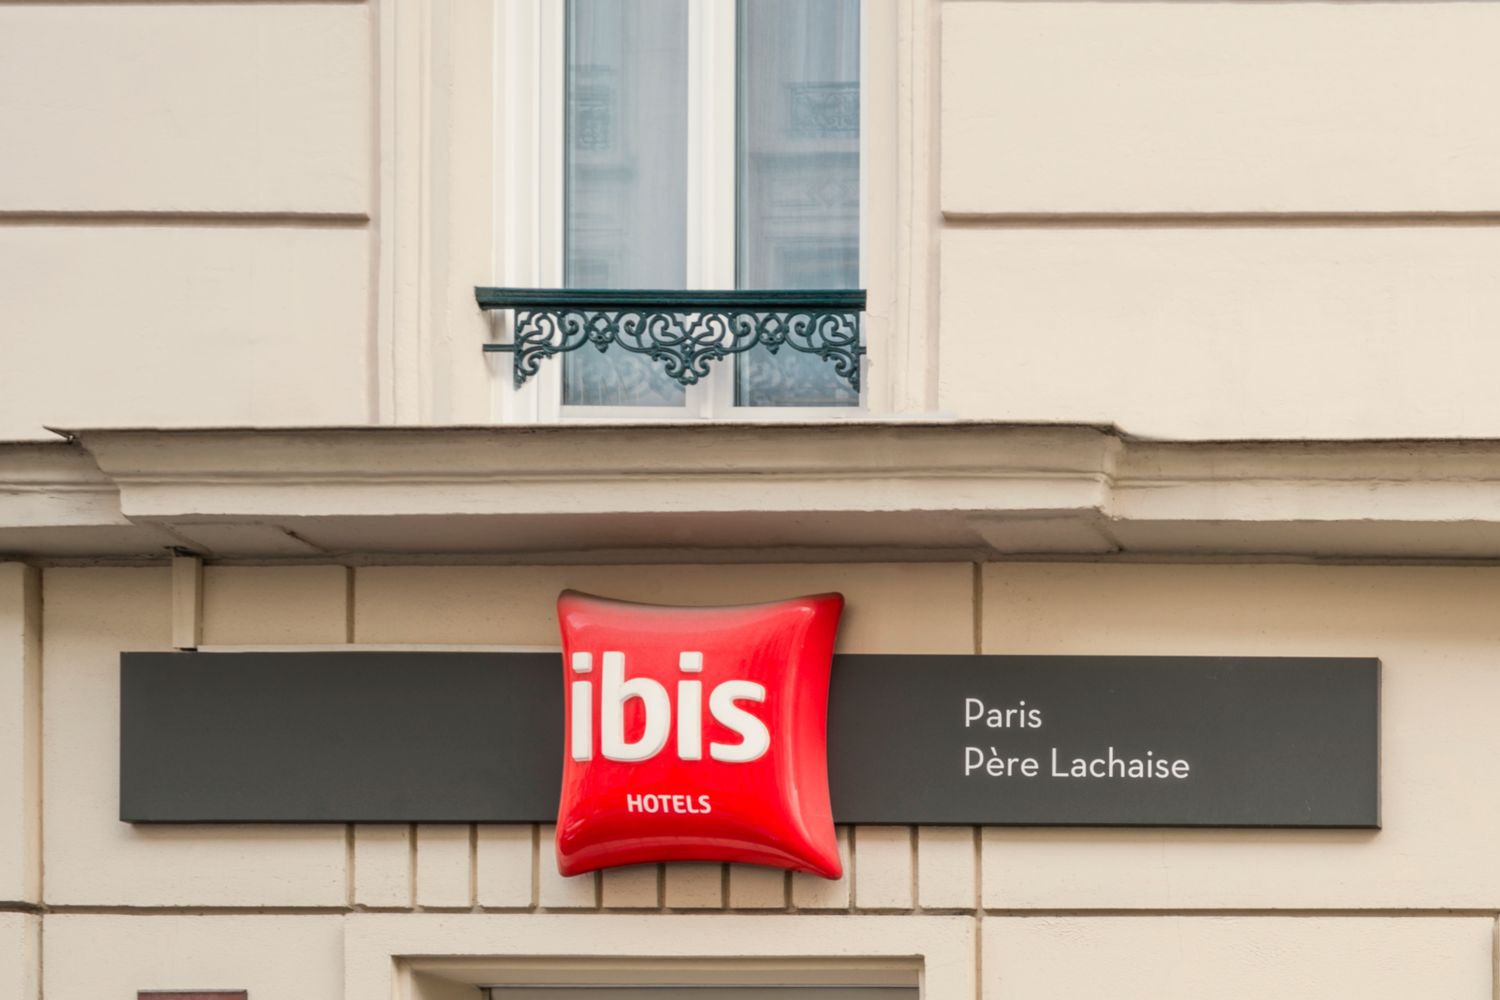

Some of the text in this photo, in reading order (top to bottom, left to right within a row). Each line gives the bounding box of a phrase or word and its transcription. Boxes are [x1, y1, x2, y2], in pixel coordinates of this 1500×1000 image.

[571, 651, 770, 762] ibis
[965, 699, 1042, 728] Paris
[965, 744, 1190, 779] Père Lachaise
[627, 794, 711, 814] HOTELS
